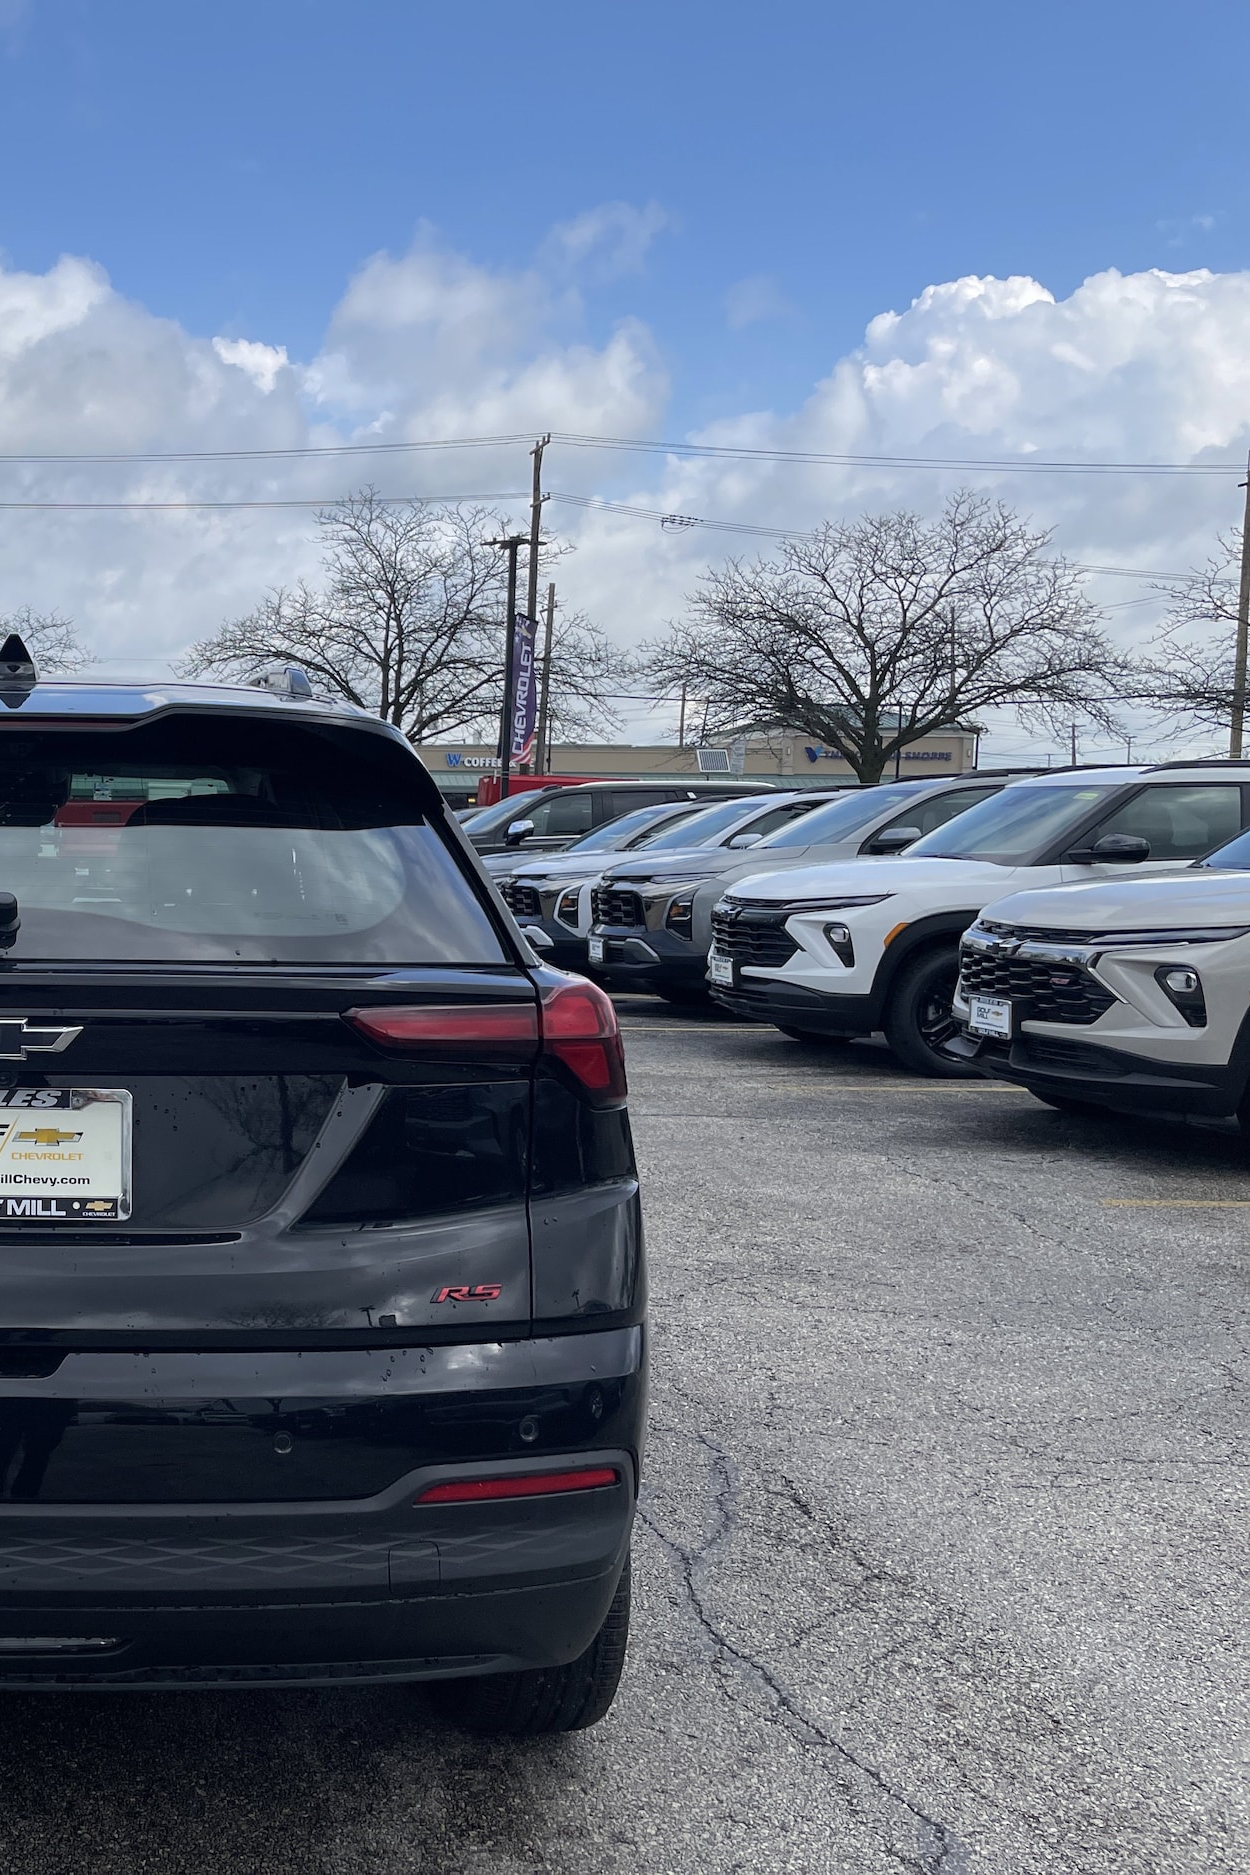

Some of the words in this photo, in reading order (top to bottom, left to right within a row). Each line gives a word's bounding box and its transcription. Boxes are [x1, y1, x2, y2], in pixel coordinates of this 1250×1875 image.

[511, 641, 533, 755] CHEVROLET
[464, 757, 503, 768] COFFEE
[11, 1152, 84, 1161] CHEVROLET
[6, 1199, 67, 1216] MILL
[430, 1283, 503, 1303] RS
